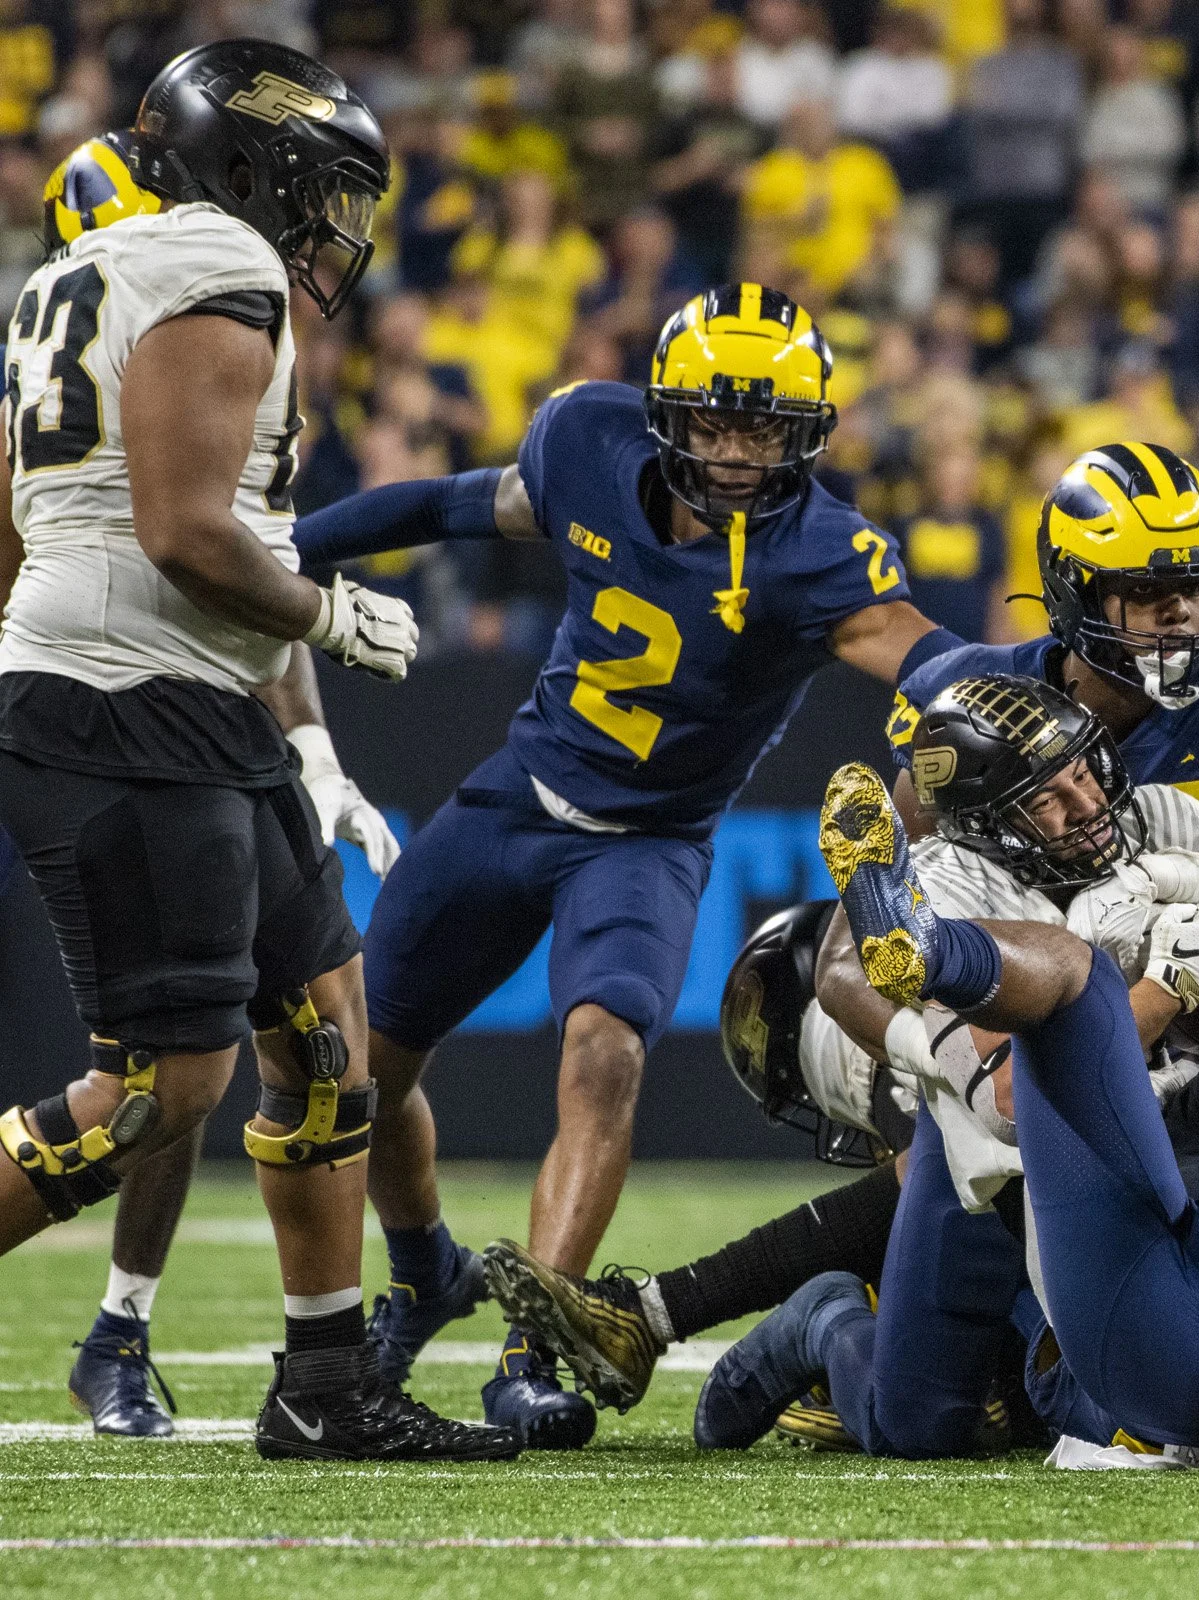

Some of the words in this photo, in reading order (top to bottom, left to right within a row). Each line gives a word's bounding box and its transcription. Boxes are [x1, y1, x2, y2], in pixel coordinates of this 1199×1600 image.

[225, 70, 337, 126] P
[732, 378, 751, 392] M
[852, 528, 900, 595] 2
[1171, 548, 1191, 564] M
[570, 586, 683, 762] 2
[912, 745, 958, 805] P
